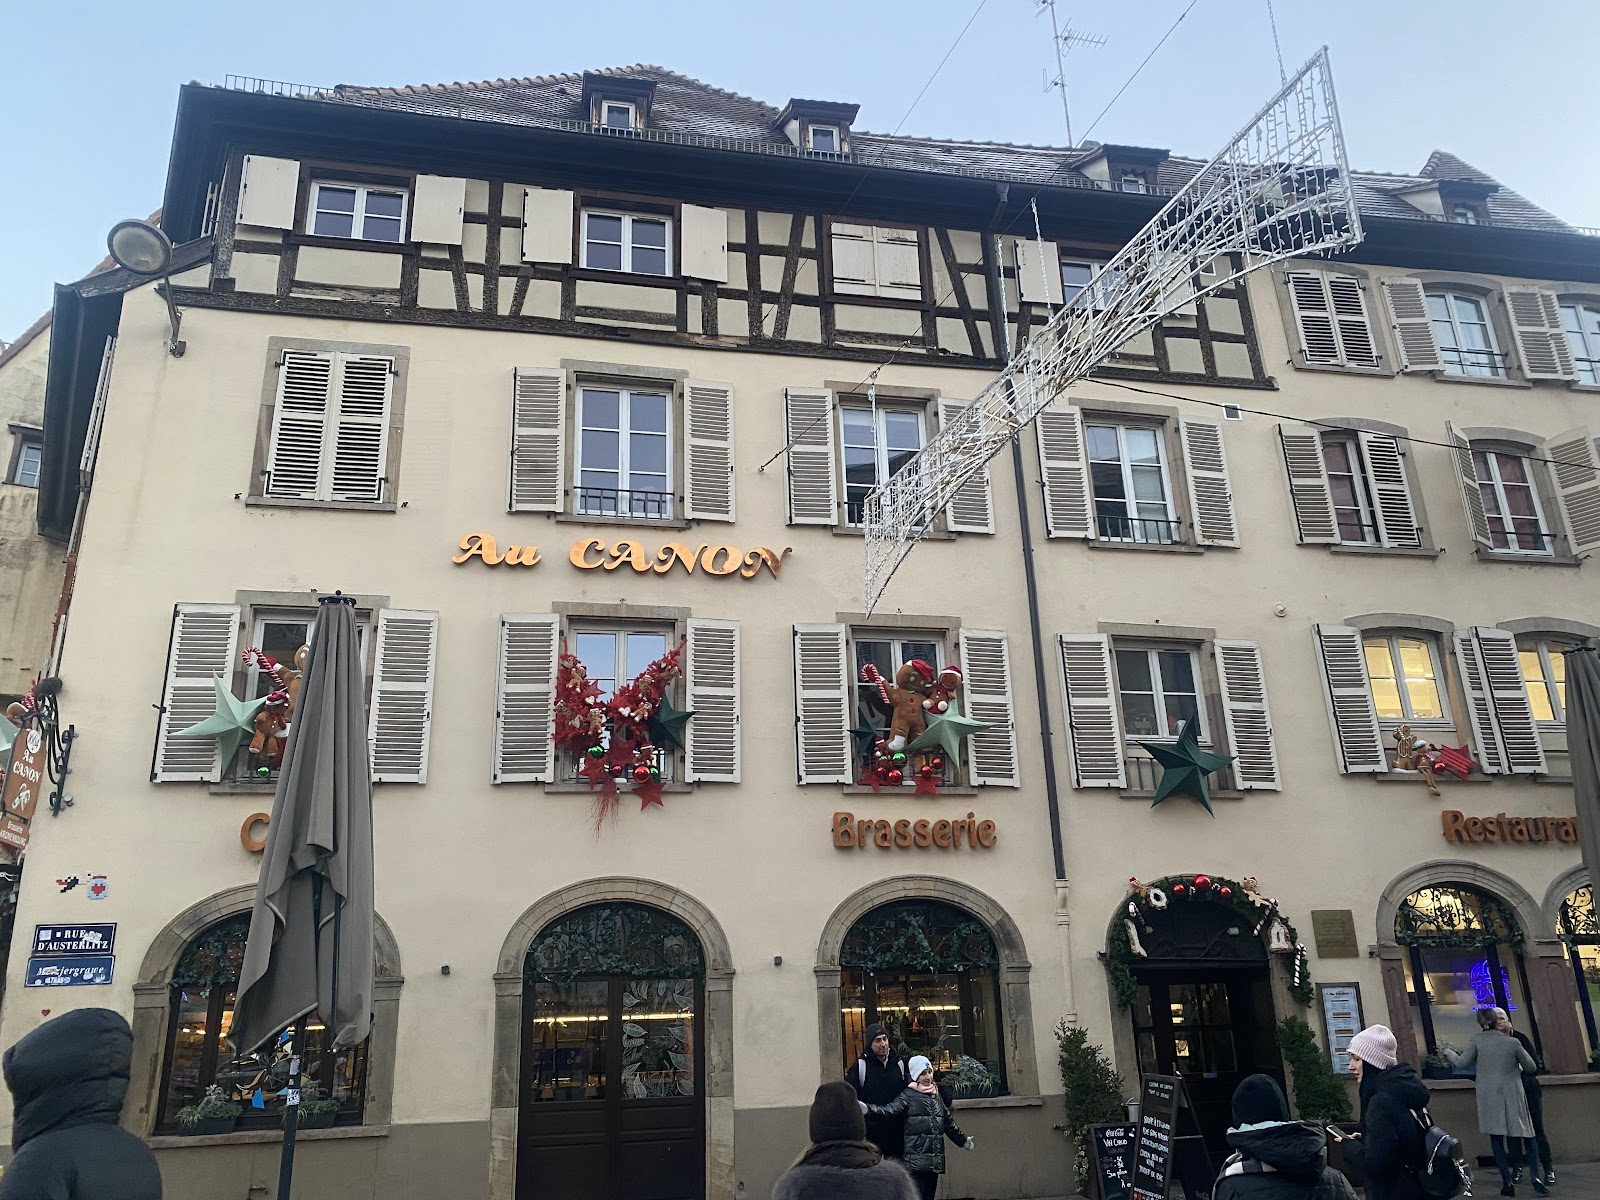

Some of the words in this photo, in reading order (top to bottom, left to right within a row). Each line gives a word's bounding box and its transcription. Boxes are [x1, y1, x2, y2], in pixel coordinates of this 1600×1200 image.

[452, 531, 543, 567] Au
[568, 536, 793, 580] CANON
[22, 749, 34, 764] Au
[13, 761, 42, 783] CANON
[832, 811, 997, 848] Brasserie
[64, 929, 86, 939] RUE
